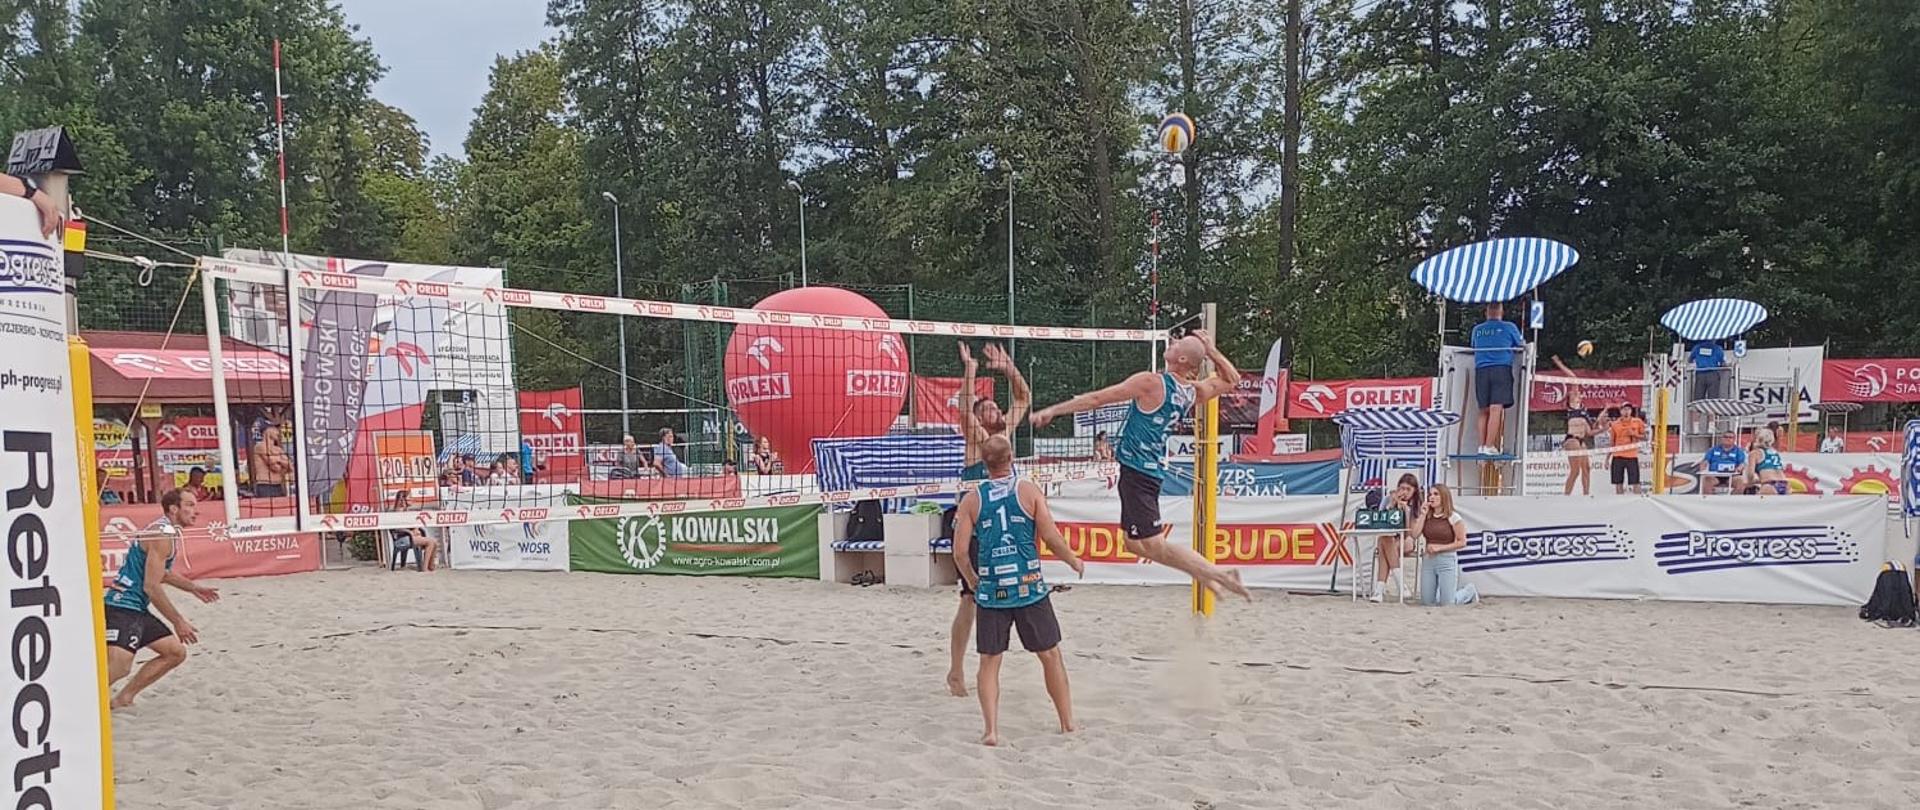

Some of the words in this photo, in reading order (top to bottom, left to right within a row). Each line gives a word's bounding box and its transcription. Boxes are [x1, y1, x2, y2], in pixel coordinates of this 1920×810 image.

[323, 274, 355, 287] ORLEN
[417, 284, 448, 296] ORLEN
[503, 292, 530, 302] ORLEN
[580, 298, 605, 309] ORLEN
[650, 305, 672, 314] ORLEN
[713, 311, 733, 319] ORLEN
[1533, 303, 1543, 325] 2
[1735, 342, 1745, 357] 3
[731, 377, 785, 400] ORLEN
[852, 374, 906, 393] ORLEN
[1350, 389, 1417, 406] ORLEN
[1579, 389, 1628, 399] ATKÓWKA
[1738, 382, 1812, 405] EŚNIA
[1163, 411, 1180, 431] 2
[662, 502, 685, 512] ORLEN
[723, 499, 745, 508] ORLEN
[520, 509, 547, 519] ORLEN
[594, 506, 619, 516] ORLEN
[345, 516, 377, 527] ORLEN
[438, 513, 467, 523] ORLEN
[996, 505, 1008, 531] 1
[672, 517, 779, 543] KOWALSKI
[1130, 525, 1139, 536] 2
[233, 536, 300, 554] WRZEŚNIA
[470, 540, 500, 553] WOSR
[518, 542, 550, 554] WOSR
[1481, 530, 1598, 560] Progress
[1688, 530, 1818, 562] Progress
[128, 636, 139, 649] 2
